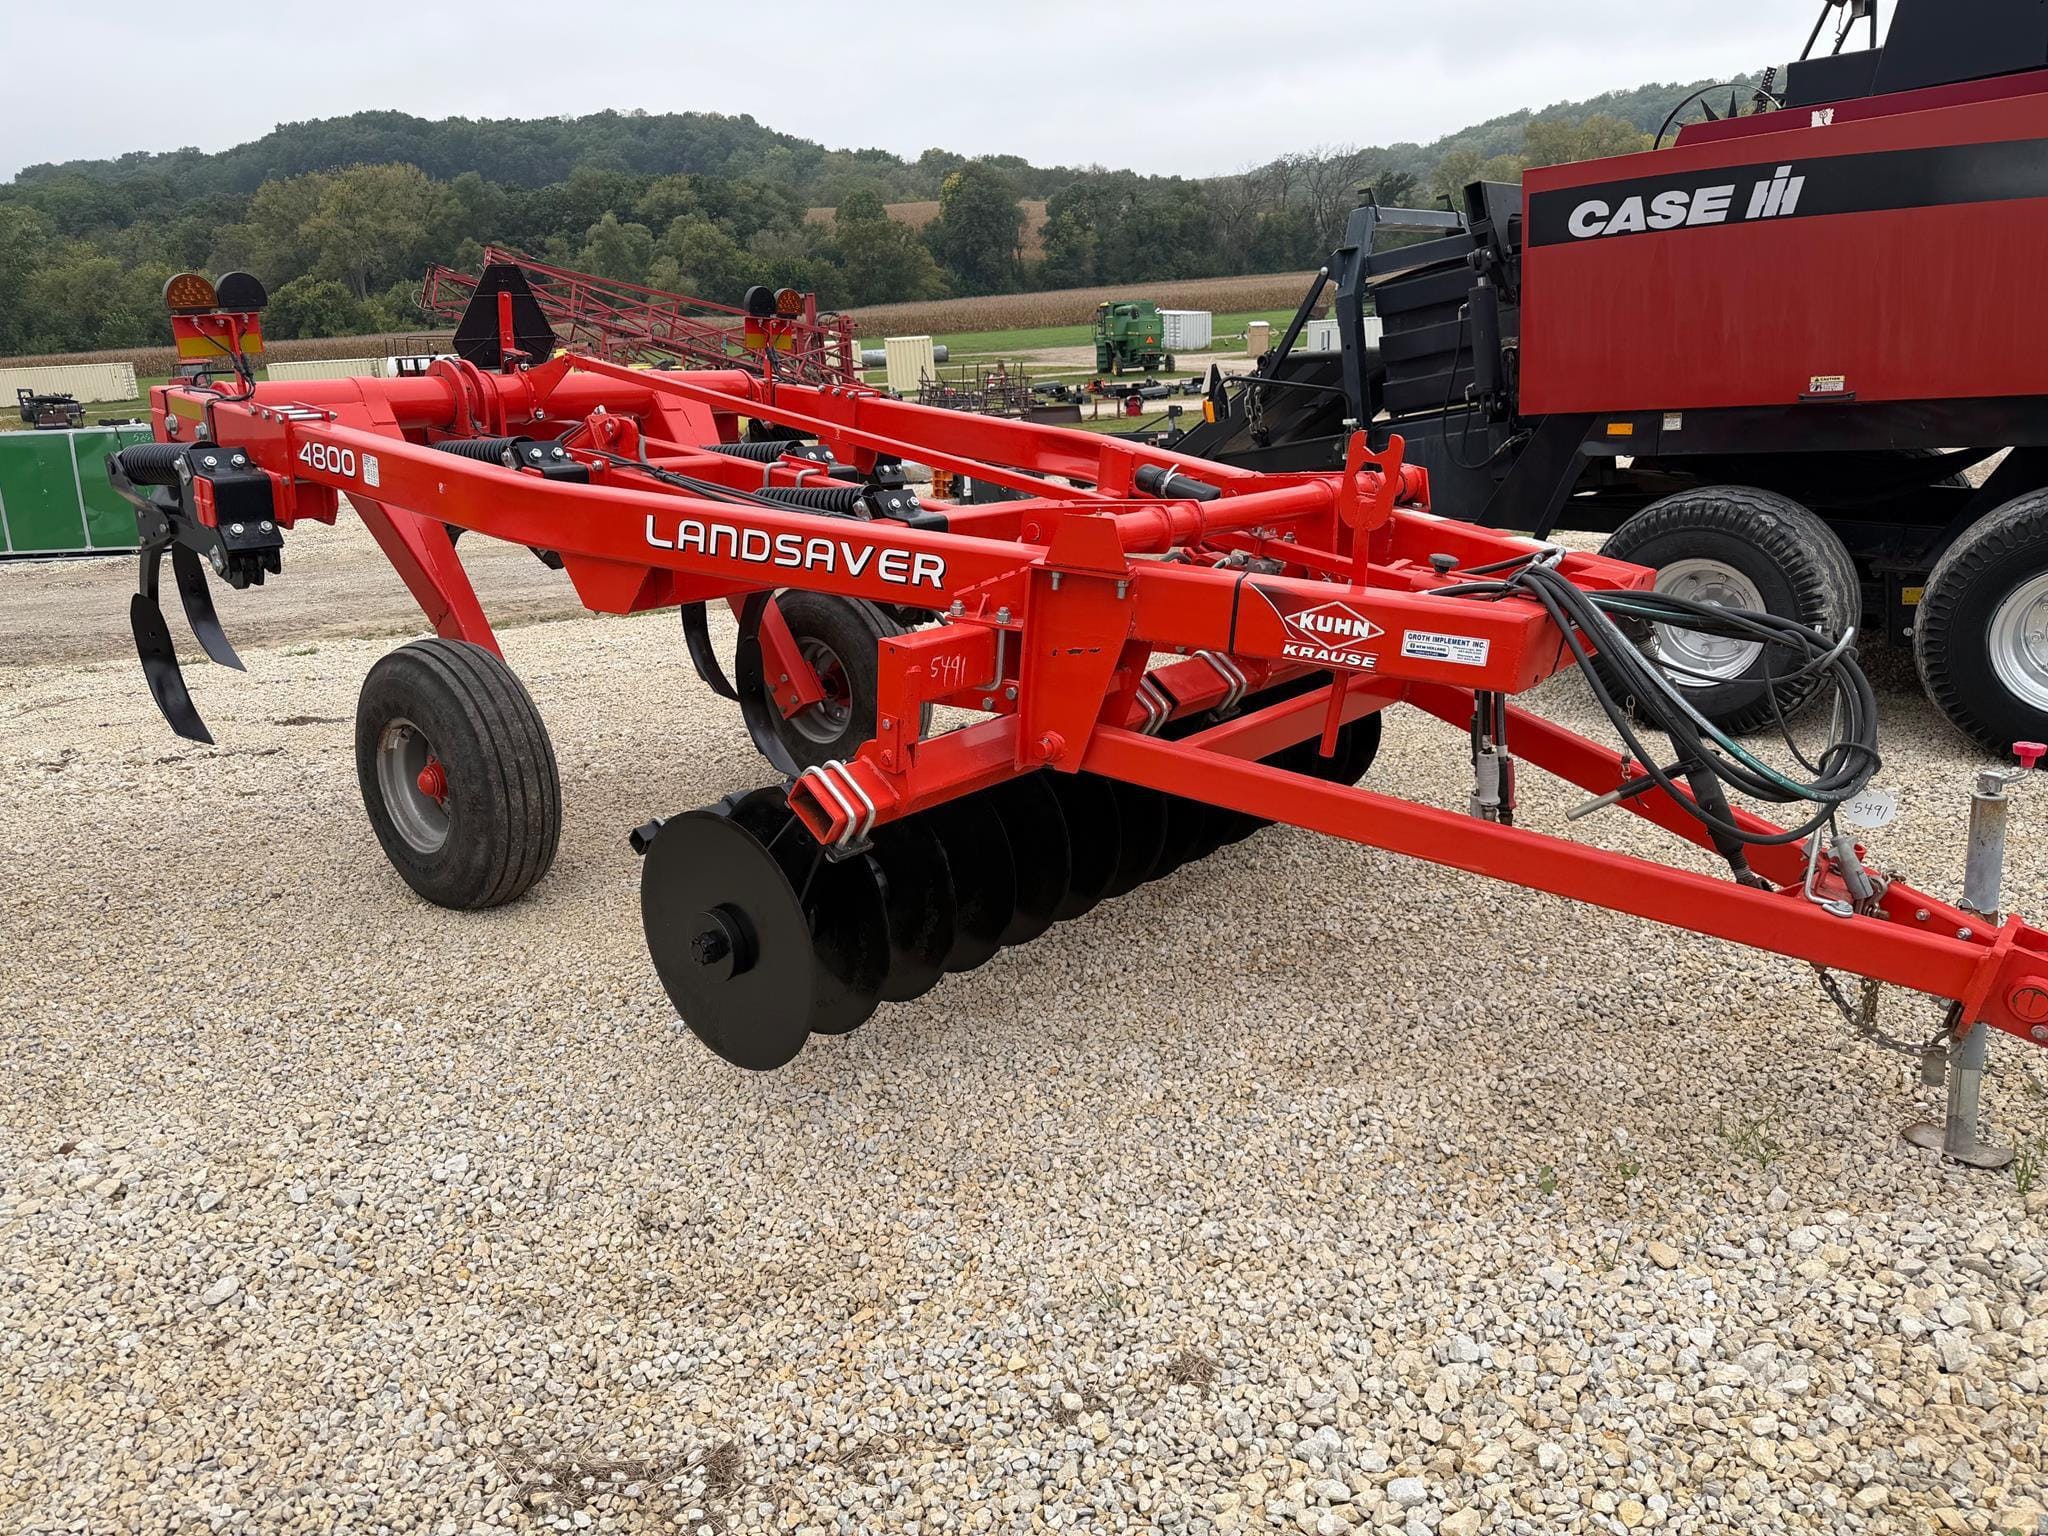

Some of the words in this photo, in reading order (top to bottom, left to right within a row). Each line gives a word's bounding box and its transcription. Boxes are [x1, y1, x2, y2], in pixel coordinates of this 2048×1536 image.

[1568, 184, 1736, 238] CASE
[298, 441, 356, 477] 4800
[645, 514, 946, 589] LANDSAVER
[1299, 612, 1371, 638] KUHN
[1407, 633, 1431, 642] GROTH
[1432, 636, 1471, 647] IMPLEMENT
[1472, 641, 1486, 649] INC.
[1282, 644, 1377, 668] KRAUSE
[930, 655, 966, 687] 5491
[1853, 802, 1889, 820] 5491
